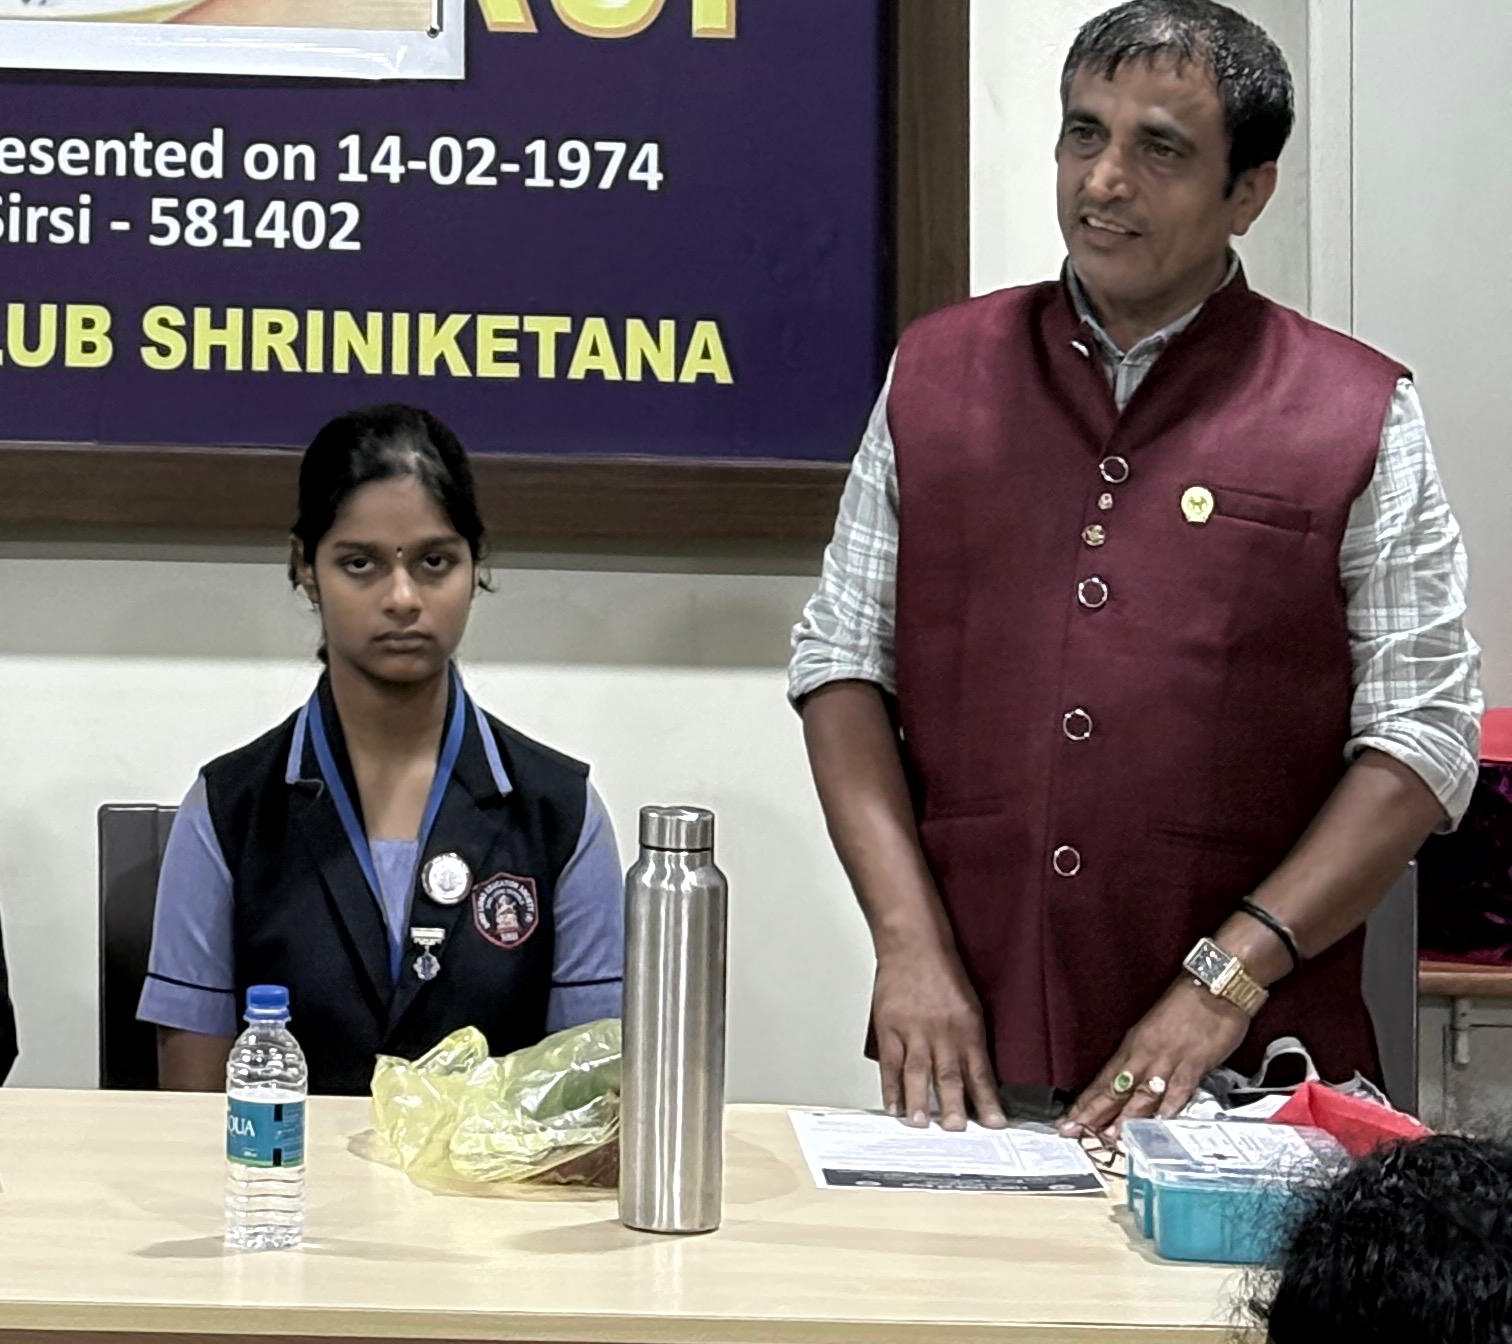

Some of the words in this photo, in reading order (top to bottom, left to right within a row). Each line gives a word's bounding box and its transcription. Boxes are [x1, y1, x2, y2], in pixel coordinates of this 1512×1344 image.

[243, 142, 316, 182] on
[337, 134, 664, 191] 14-02-1974
[148, 196, 361, 251] 581402
[140, 305, 734, 385] SHRINIKETANA
